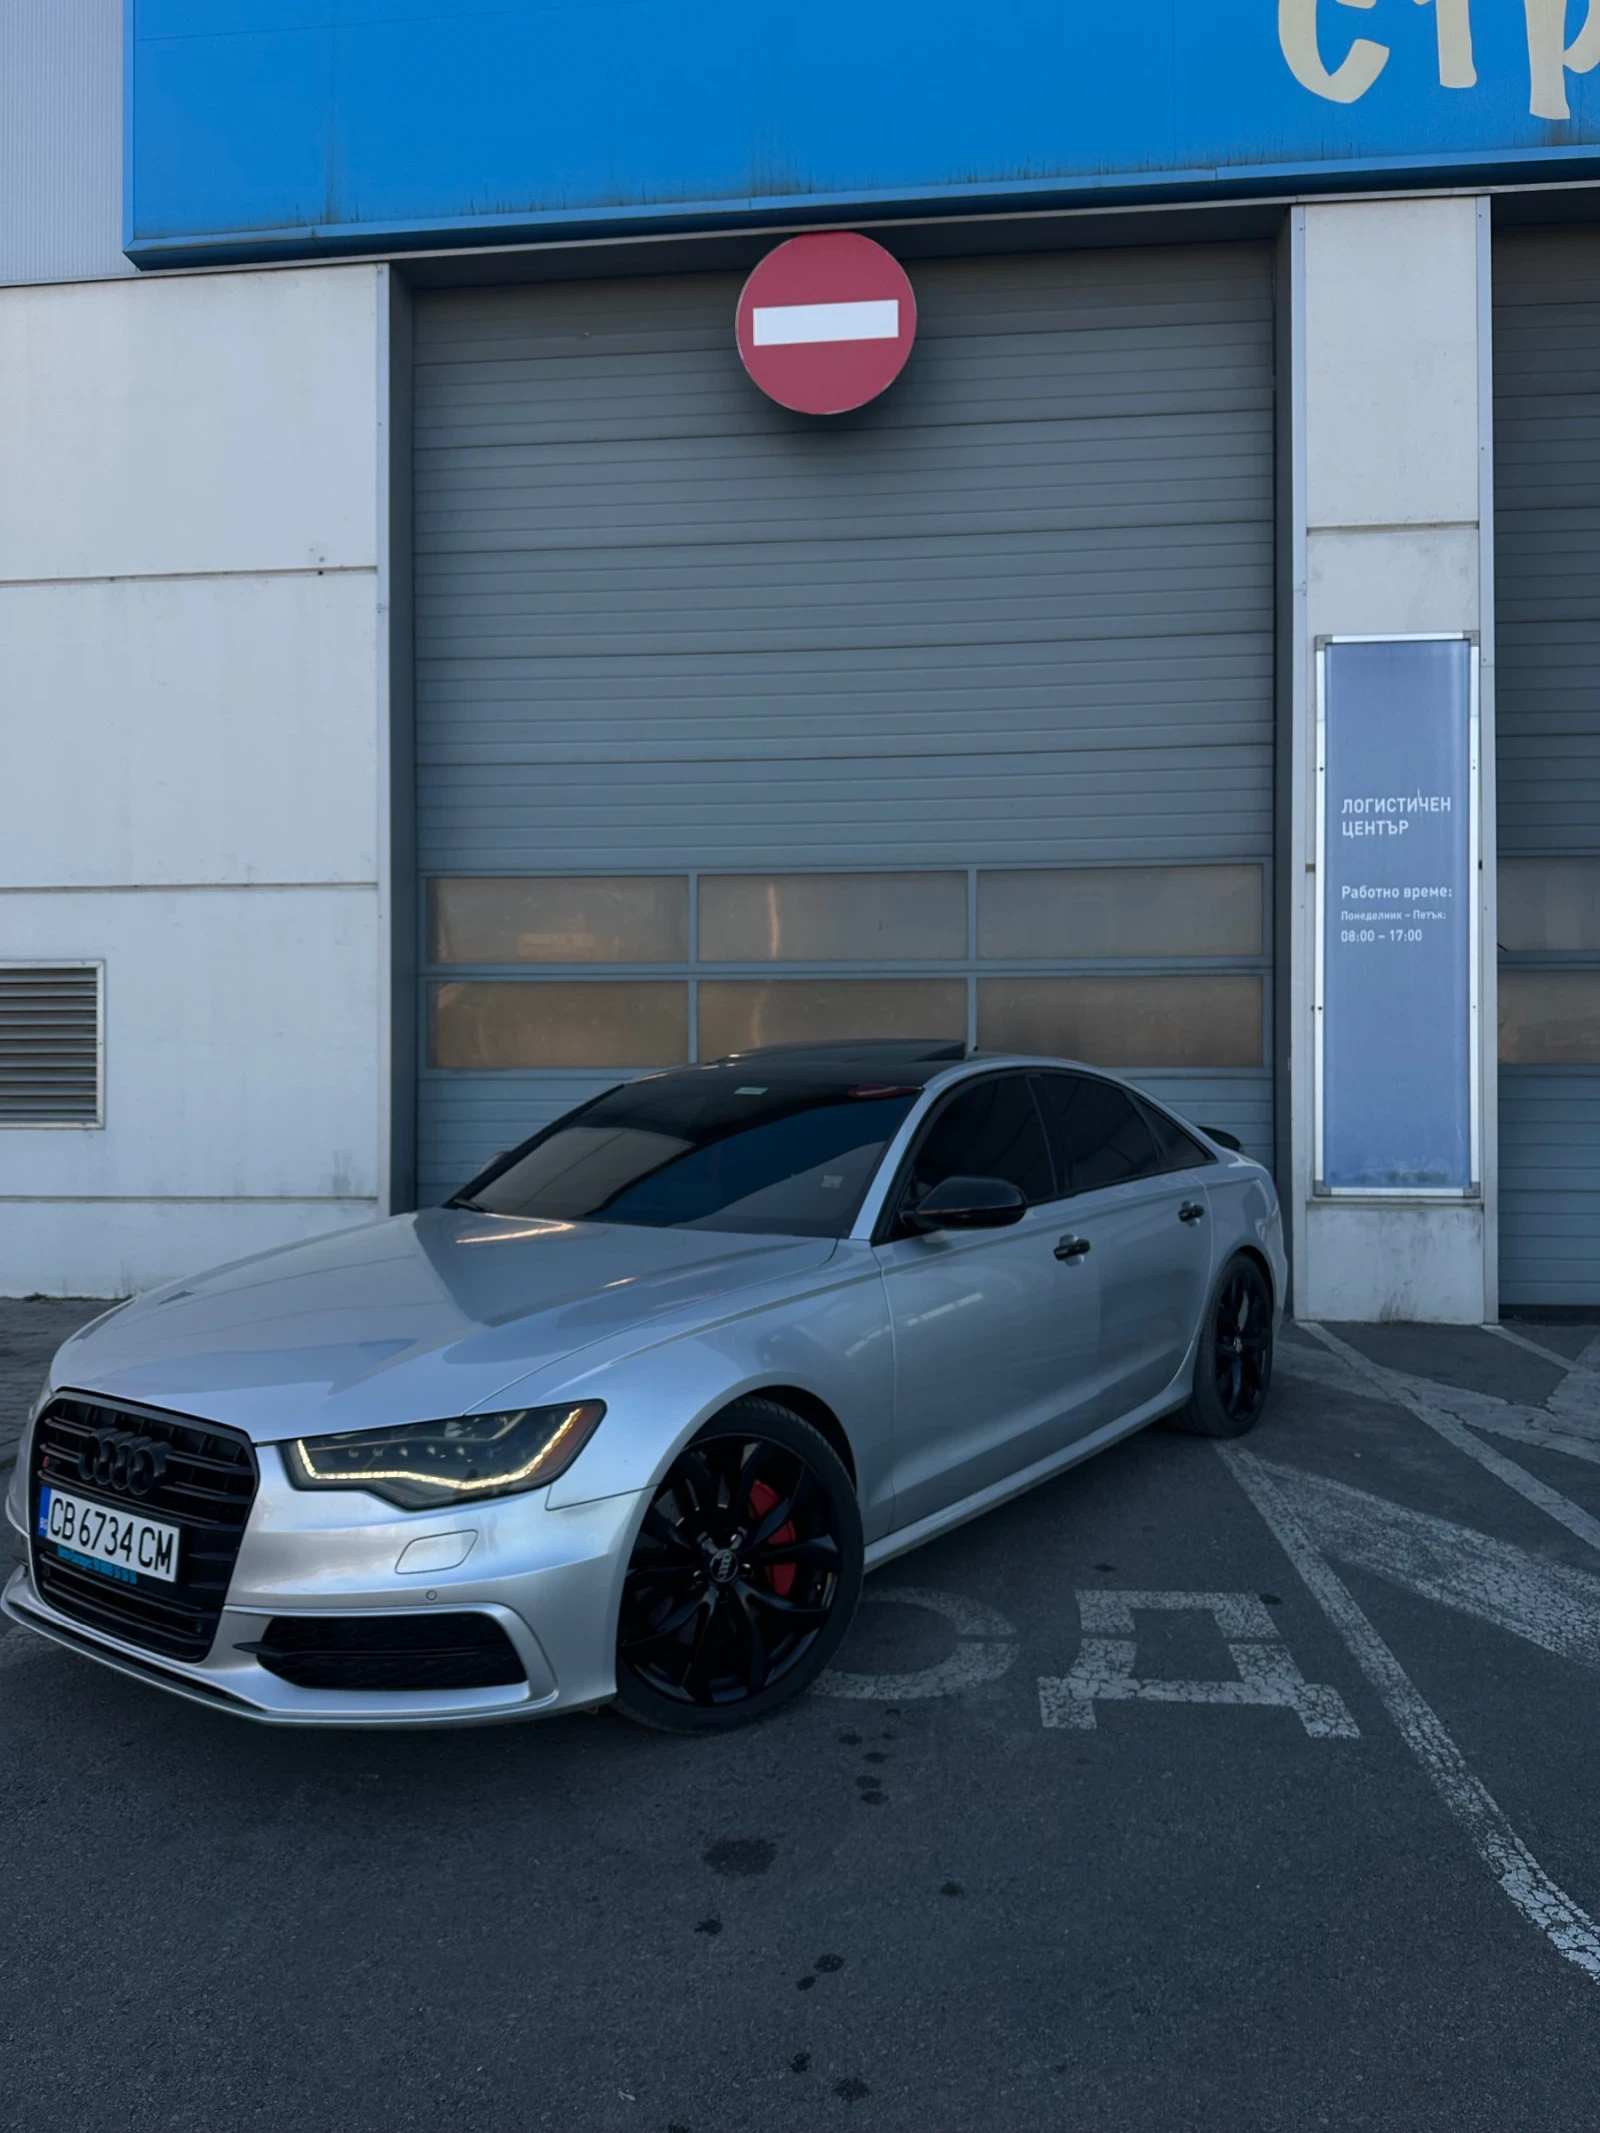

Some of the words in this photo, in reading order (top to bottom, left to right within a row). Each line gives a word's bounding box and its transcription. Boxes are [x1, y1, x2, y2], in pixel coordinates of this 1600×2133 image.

[1341, 797, 1451, 814] ЛОГИСТИЧЕН
[1342, 820, 1409, 838] ЦЕНТЪР
[1341, 885, 1400, 899] Работно
[1404, 886, 1452, 901] време:
[1341, 910, 1402, 921] Понеделник
[1413, 909, 1446, 920] Петък:
[1341, 930, 1375, 942] 08:00
[1389, 929, 1422, 941] 17:00
